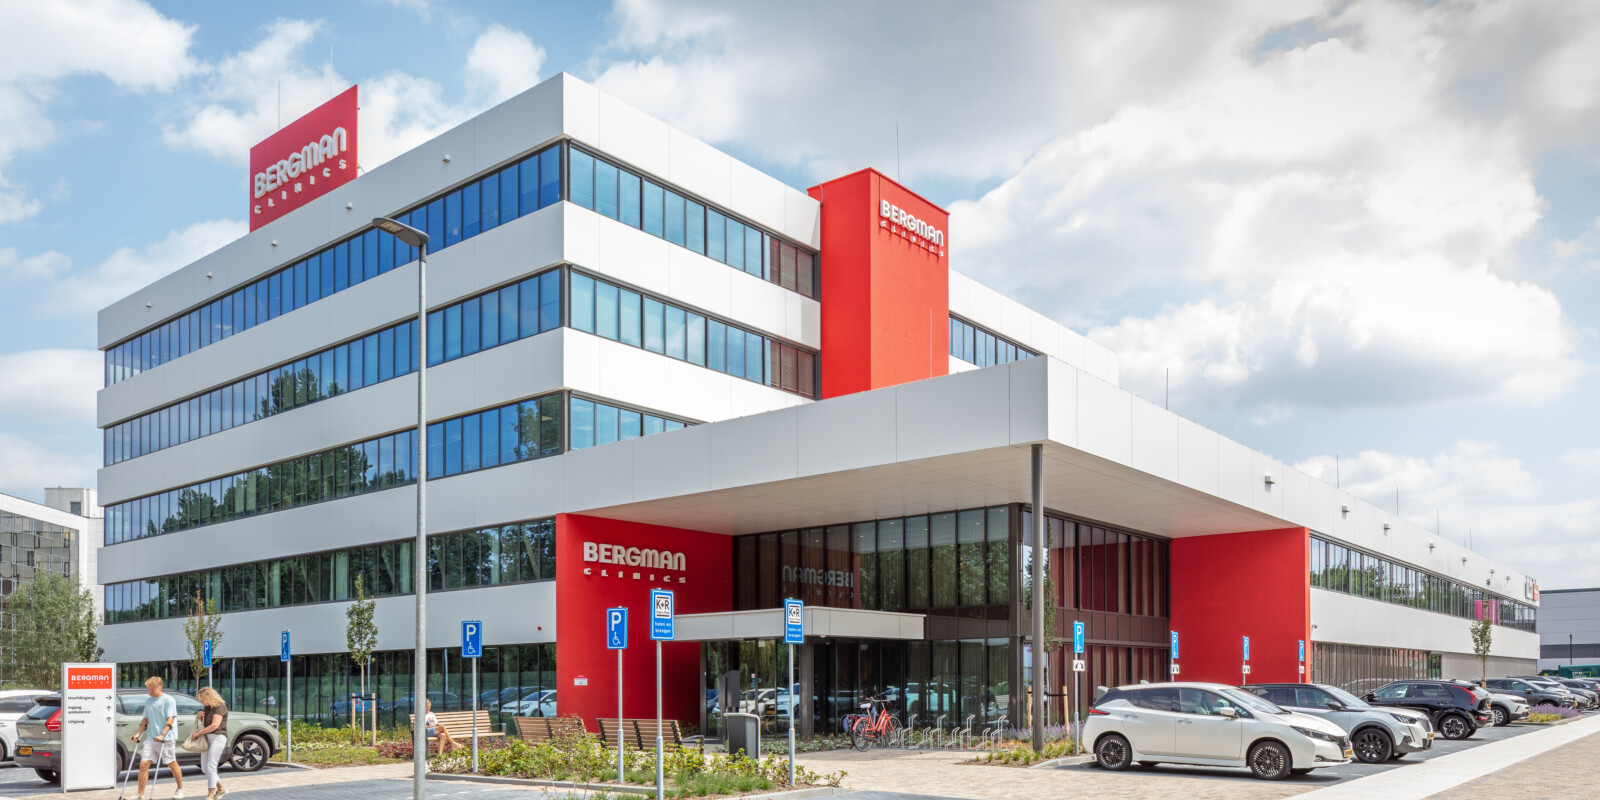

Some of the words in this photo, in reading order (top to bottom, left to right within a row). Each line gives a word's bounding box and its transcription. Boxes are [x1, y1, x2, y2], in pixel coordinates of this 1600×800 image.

[254, 126, 347, 199] BERGMAN
[254, 159, 347, 214] CLINICS
[880, 199, 944, 247] BERGMAN
[880, 220, 944, 257] CLINICS
[583, 541, 686, 571] BERGMAN
[583, 567, 686, 584] CLINICS
[655, 599, 670, 610] K+R
[466, 624, 477, 642] P
[611, 611, 622, 632] P
[282, 633, 288, 648] P
